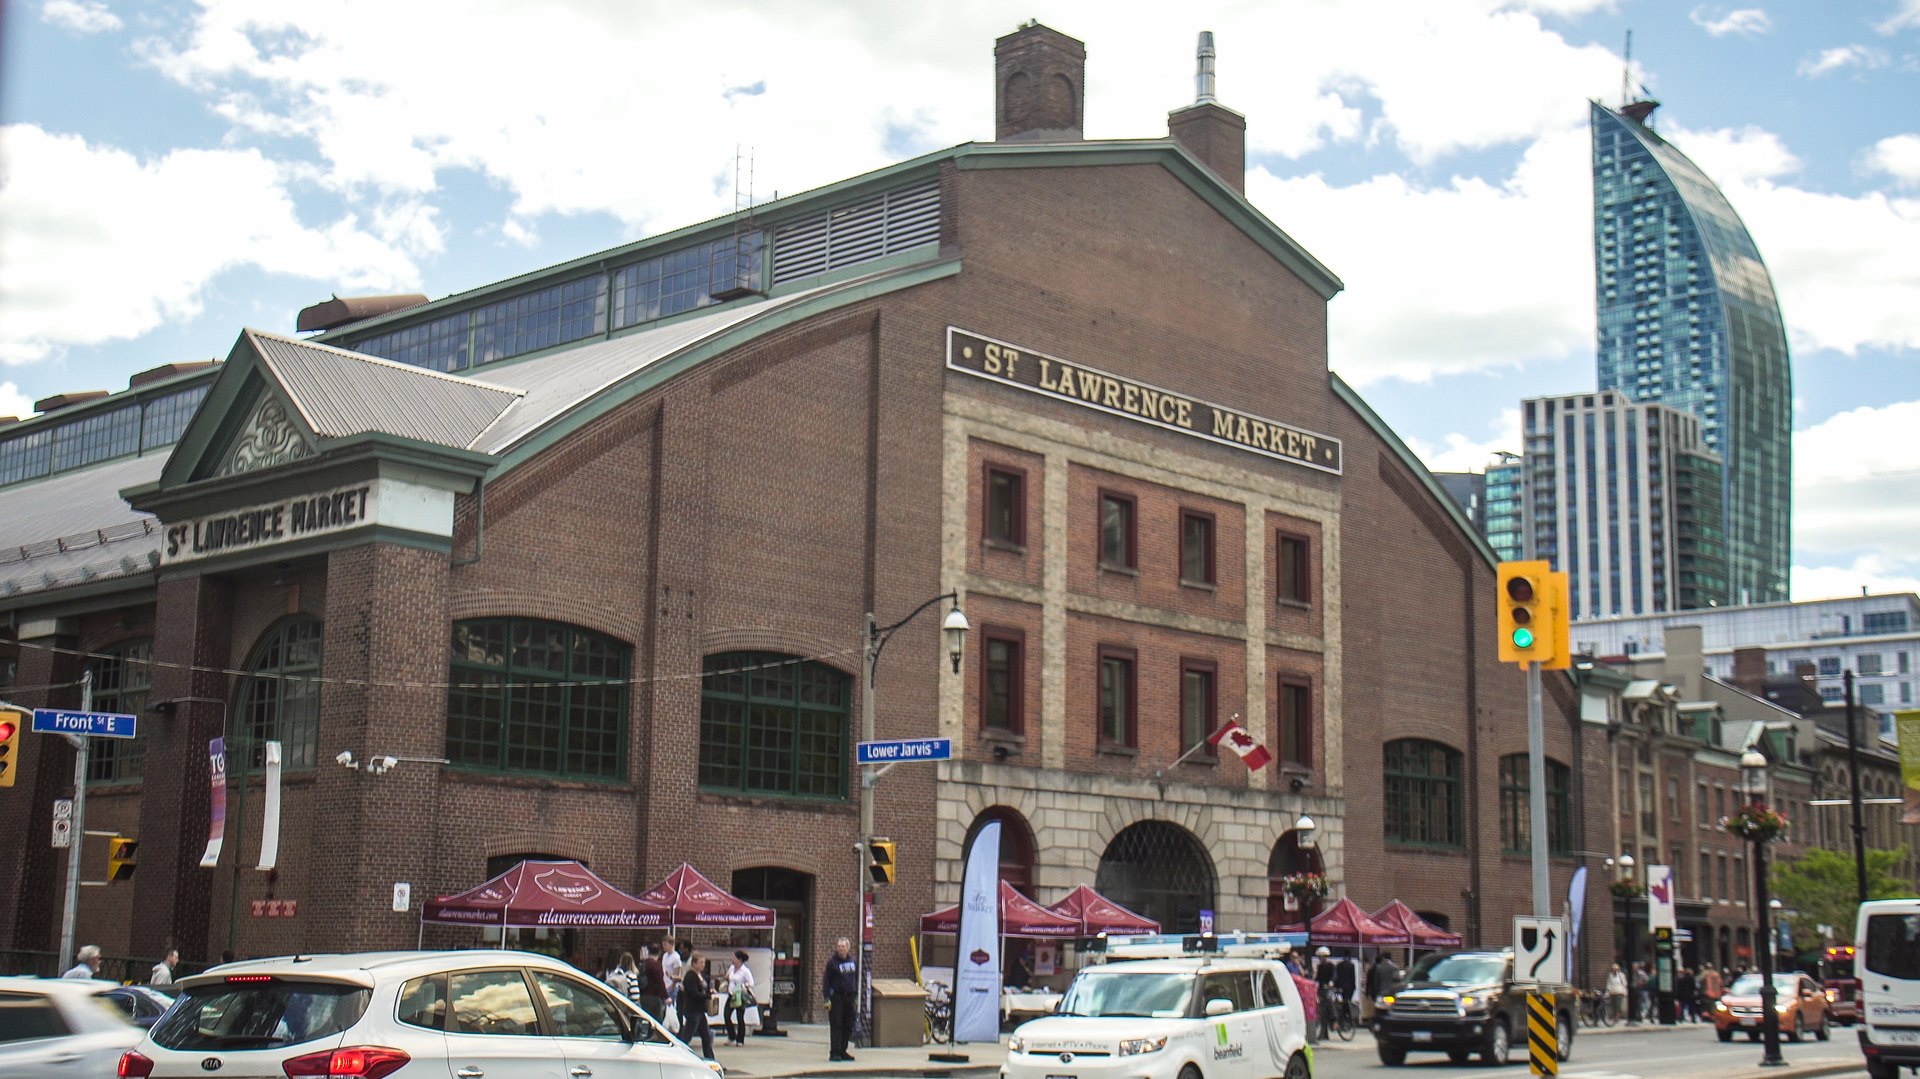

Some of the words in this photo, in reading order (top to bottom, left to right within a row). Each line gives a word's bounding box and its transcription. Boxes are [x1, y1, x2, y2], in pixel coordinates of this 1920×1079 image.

[1039, 358, 1192, 429] LAWRENCE
[1211, 408, 1317, 462] MARKET
[193, 506, 284, 553] LAWRENCE
[290, 487, 370, 535] MARKET
[55, 713, 93, 731] Front
[107, 716, 116, 731] E
[867, 743, 899, 759] Lower
[900, 741, 932, 757] Jarvis
[210, 752, 225, 774] TO
[537, 907, 661, 926] stlawrencemarket.com
[695, 910, 766, 922] stlawrencemarket.com
[203, 1059, 219, 1069] KIA
